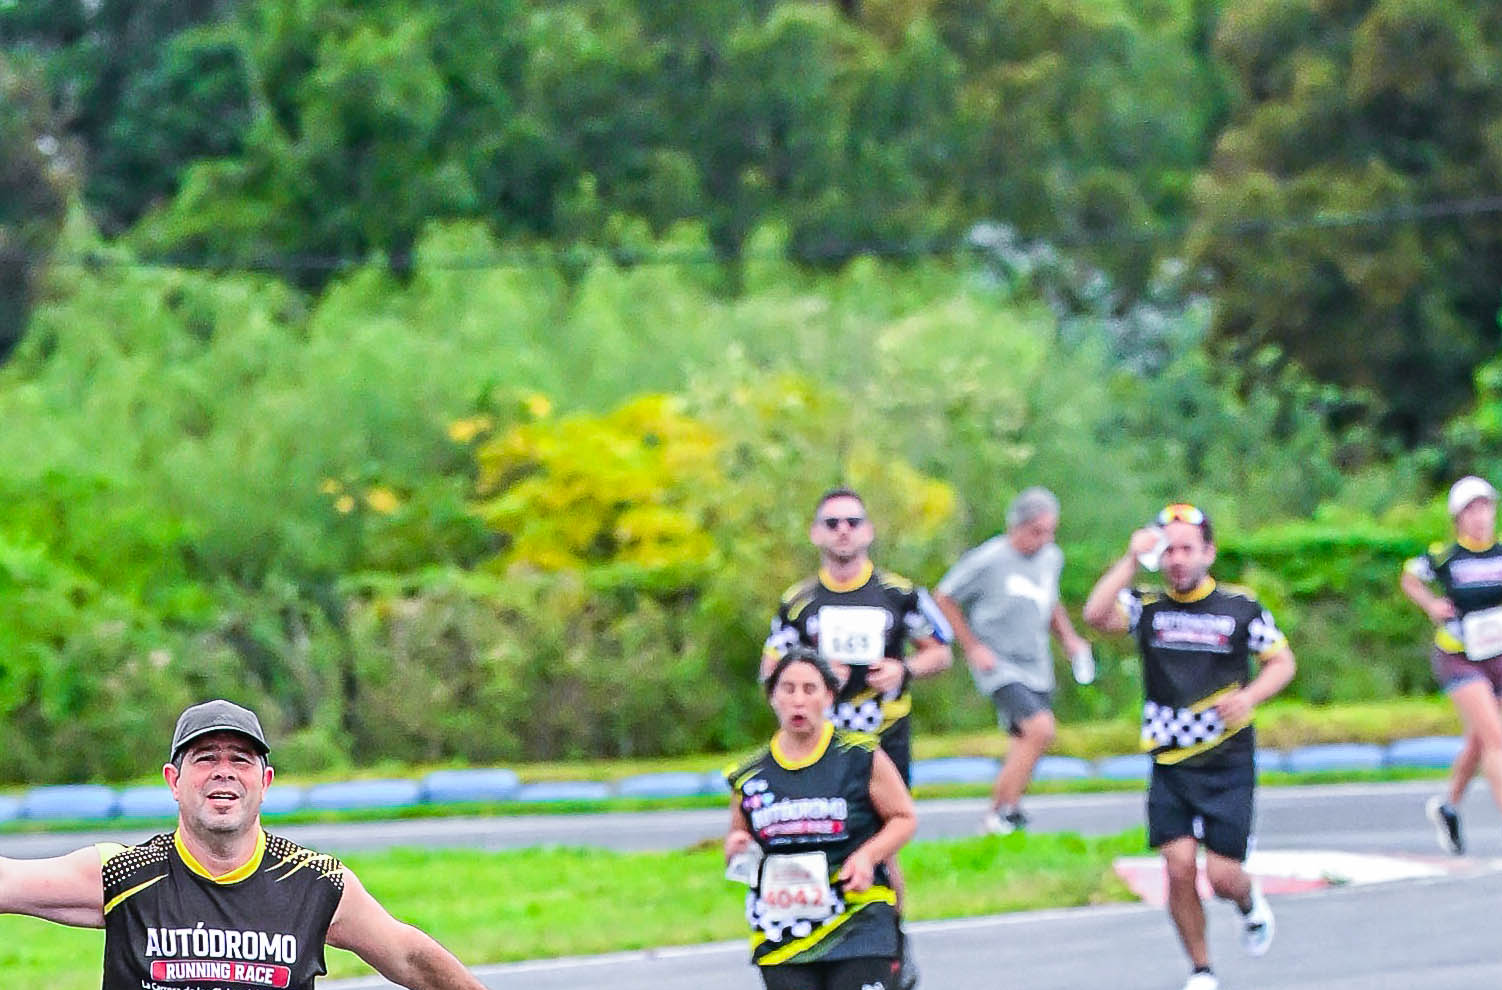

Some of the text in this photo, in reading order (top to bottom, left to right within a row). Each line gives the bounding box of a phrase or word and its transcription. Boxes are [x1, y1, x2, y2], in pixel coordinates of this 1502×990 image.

[145, 922, 297, 964] AUTÓDROMO
[141, 979, 151, 990] La
[165, 962, 275, 985] RUNNING RACE
